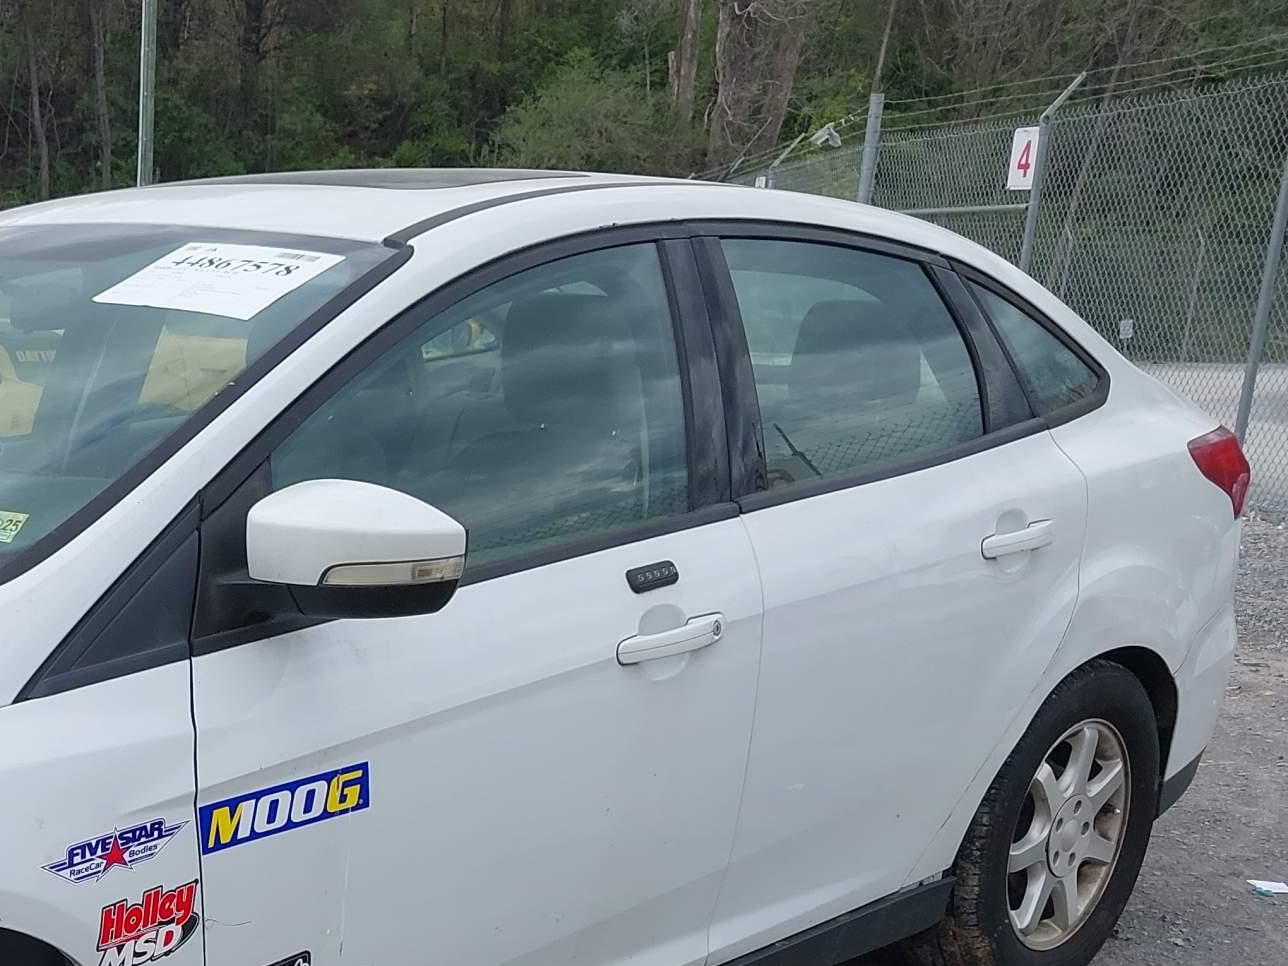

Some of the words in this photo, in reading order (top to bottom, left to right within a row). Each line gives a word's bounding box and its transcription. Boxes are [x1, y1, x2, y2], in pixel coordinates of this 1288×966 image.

[1017, 139, 1032, 178] 4
[171, 255, 300, 277] 44867578
[0, 518, 23, 533] 25
[208, 769, 363, 849] MOOG
[67, 836, 114, 867] FIVE
[117, 820, 165, 847] STAR
[128, 843, 159, 858] Bodies
[98, 881, 198, 947] Holley
